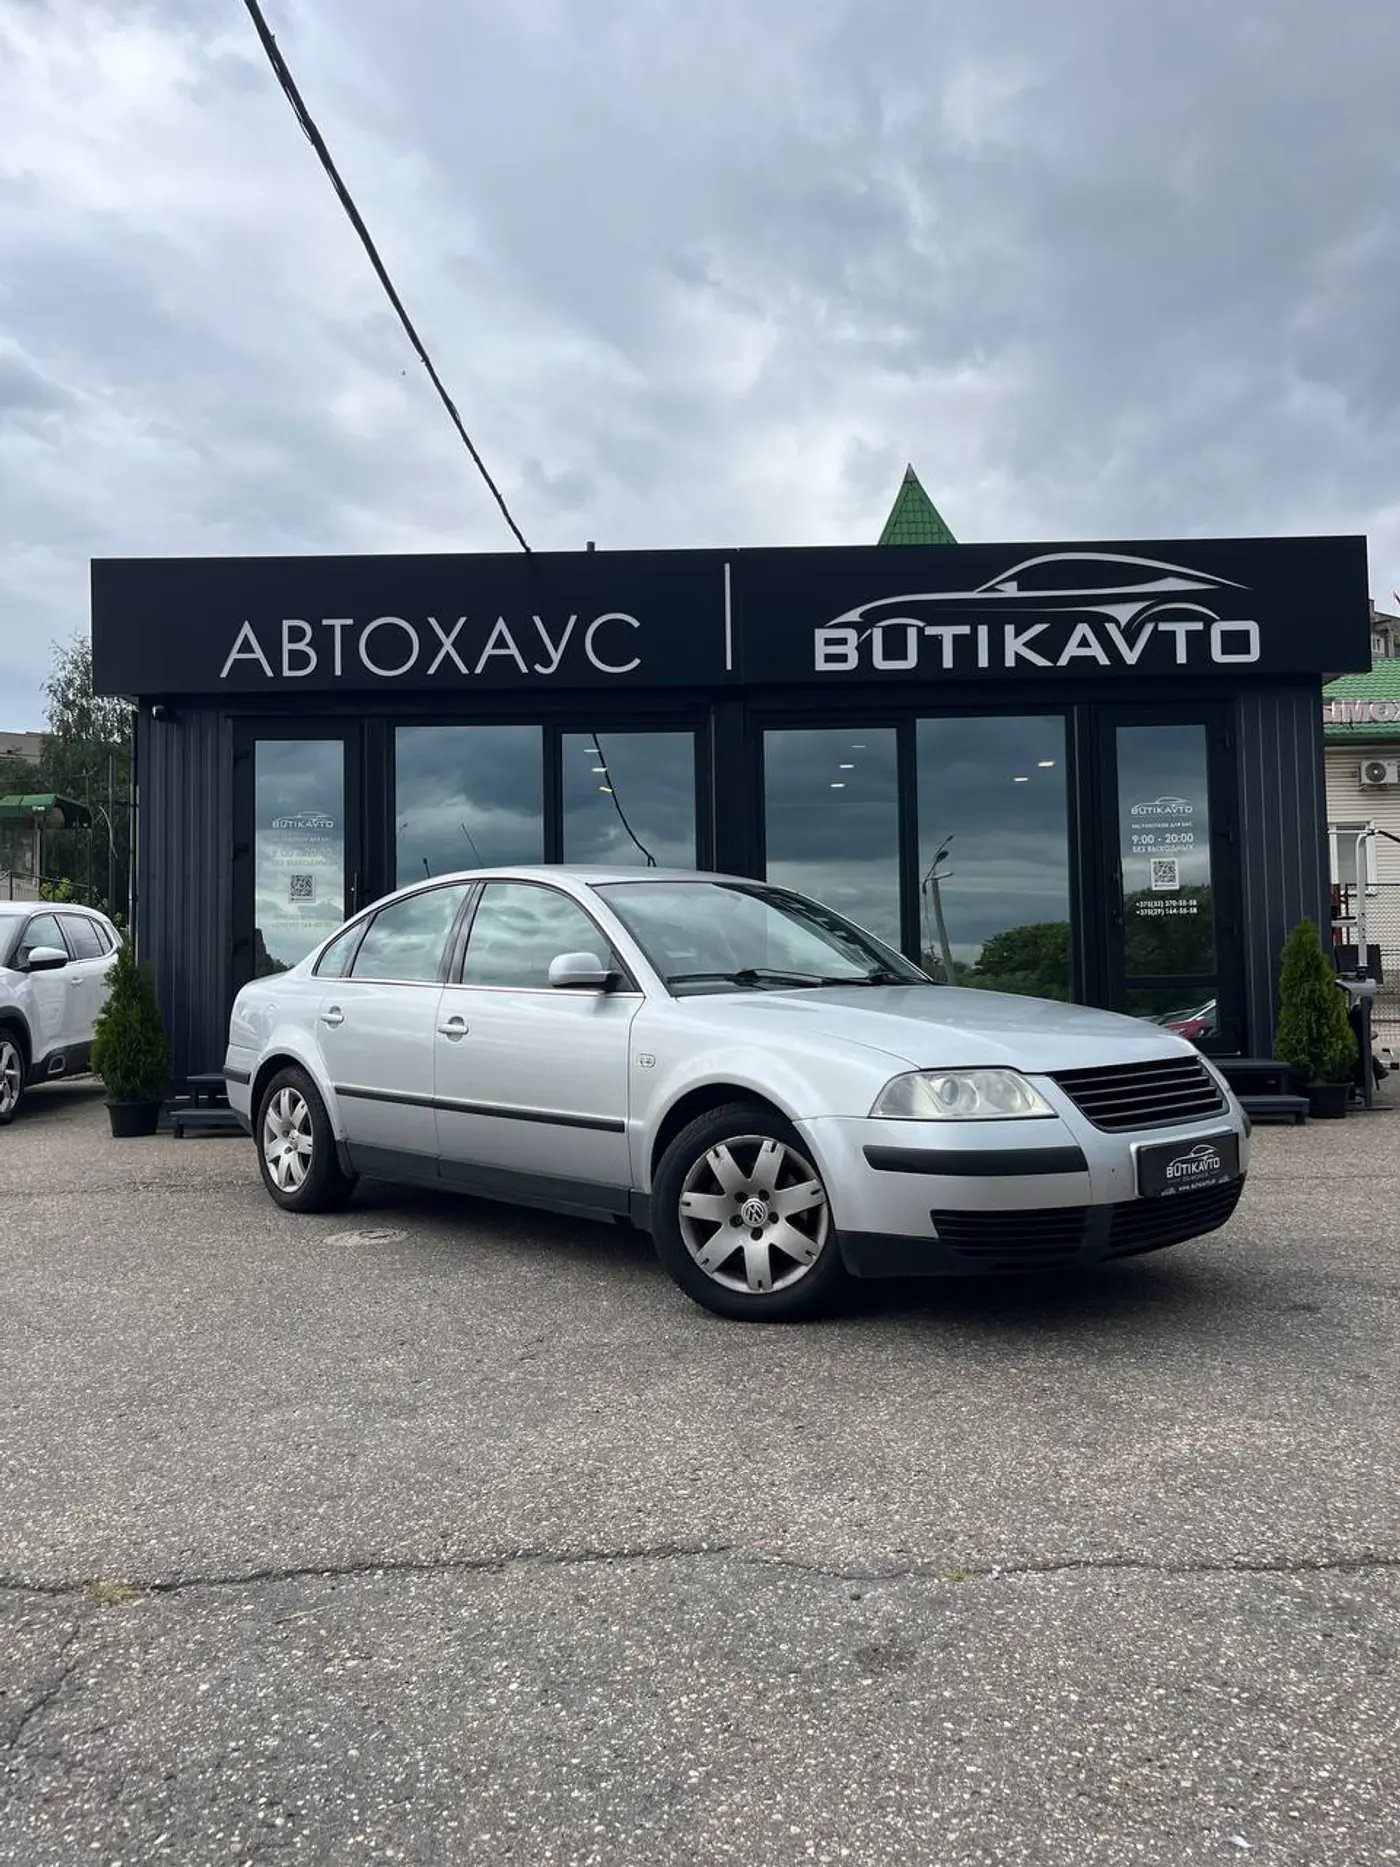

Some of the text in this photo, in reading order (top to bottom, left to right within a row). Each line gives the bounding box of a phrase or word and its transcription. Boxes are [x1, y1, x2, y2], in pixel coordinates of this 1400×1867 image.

[219, 612, 642, 678] АВТОХАУС
[813, 619, 1261, 671] BUTIKAVTO
[1131, 805, 1193, 815] BUTIKAVTO
[271, 819, 334, 829] BUTIKAVTO
[1131, 833, 1155, 845] 9:00
[1165, 832, 1194, 843] 20:00
[1166, 1157, 1221, 1179] BUTIKAVTO
